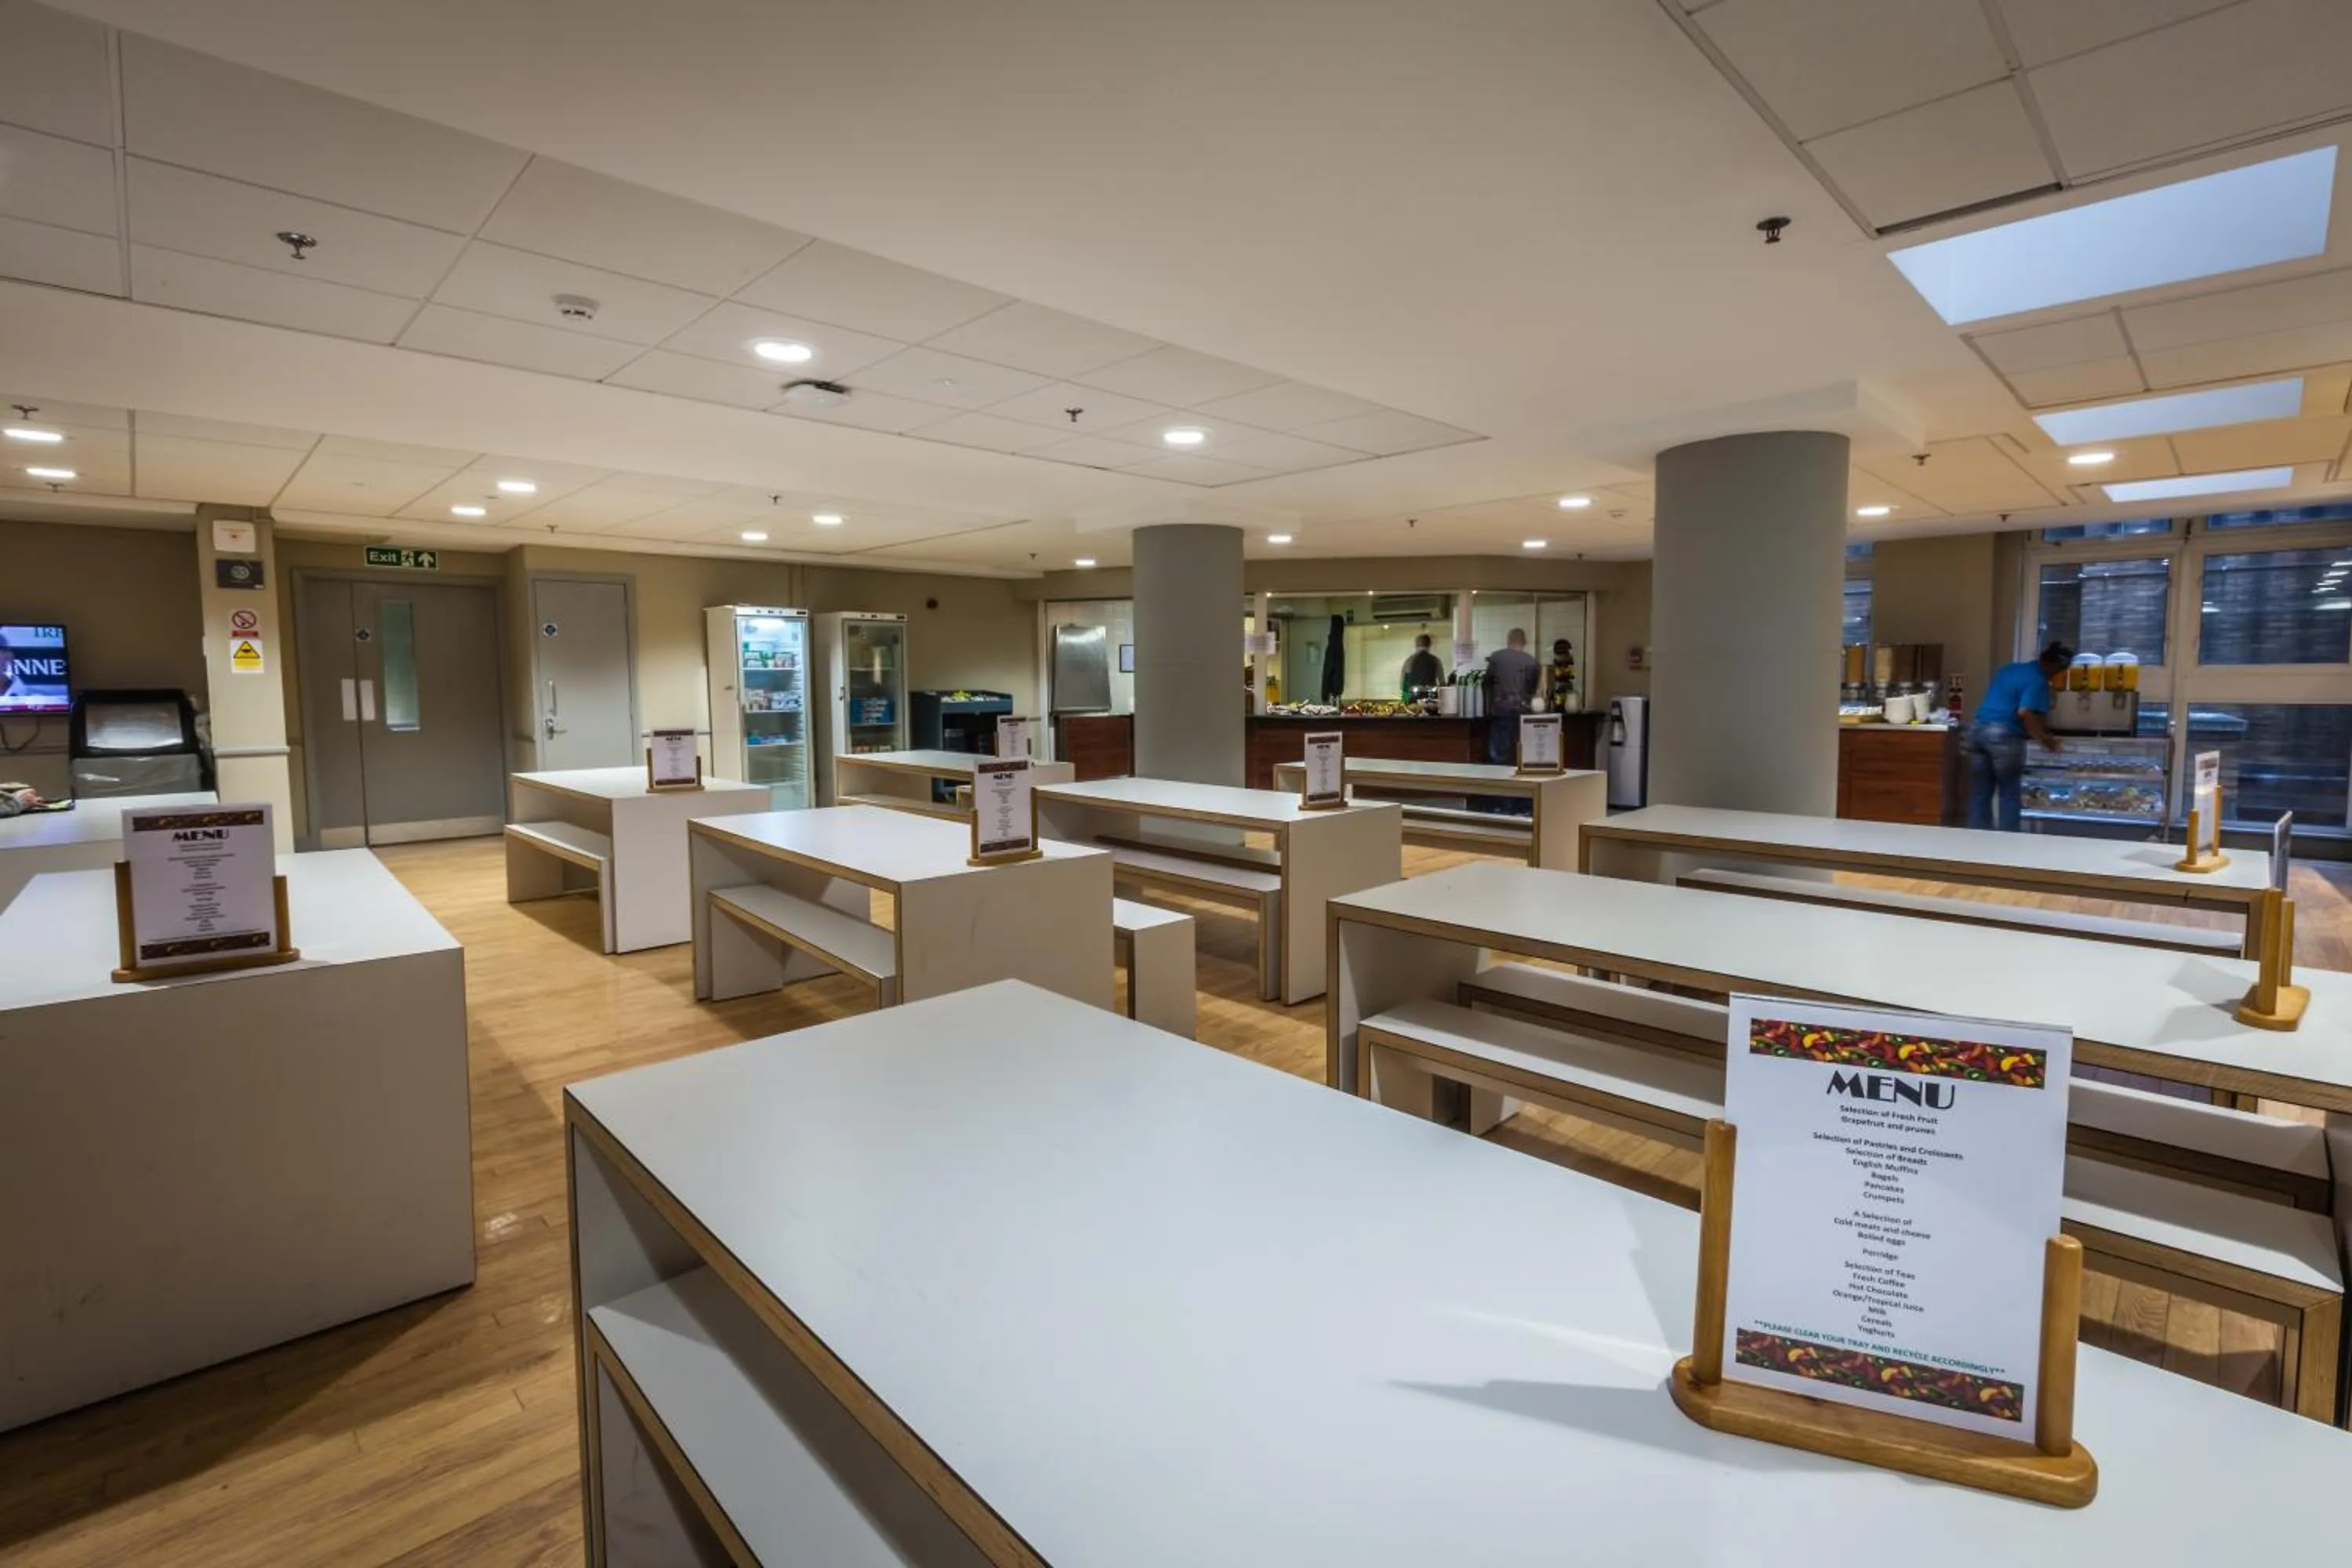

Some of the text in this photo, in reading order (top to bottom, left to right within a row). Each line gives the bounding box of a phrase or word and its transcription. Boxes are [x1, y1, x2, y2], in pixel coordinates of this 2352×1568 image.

[369, 551, 397, 563] Exit
[172, 829, 230, 842] MENU
[1826, 1069, 1955, 1109] MENU
[1840, 1105, 1879, 1117] Selection
[1892, 1112, 1915, 1122] Fresh
[1918, 1116, 1938, 1124] Fruit
[1841, 1116, 1936, 1135] Grapefruit and prunes
[1813, 1132, 1851, 1144] Selection
[1864, 1140, 1897, 1151] Pastries
[1918, 1147, 1963, 1160] Croissants
[1846, 1147, 1884, 1159] Selection
[1897, 1155, 1928, 1165] Breads
[1853, 1159, 1918, 1175] English Muffins
[1871, 1171, 1899, 1182] Bagels
[1864, 1181, 1904, 1193] Pancakes
[1863, 1191, 1904, 1204] Crumpets
[1862, 1211, 1901, 1224] Selection
[1834, 1217, 1853, 1226] Cold
[1855, 1221, 1880, 1231] meats
[1900, 1229, 1931, 1239] cheese
[1857, 1232, 1906, 1247] Boiled eggs
[1862, 1248, 1899, 1261] Porridge
[1844, 1260, 1882, 1273] Selection
[1896, 1269, 1915, 1279] Teas
[1853, 1272, 1905, 1287] Fresh Coffee
[1865, 1285, 1908, 1298] Chocolate
[1832, 1289, 1925, 1312] Orange/Tropical Juice
[1868, 1306, 1886, 1316] Milk
[1861, 1315, 1893, 1327] Cereals
[1857, 1324, 1895, 1338] Yoghurts
[1794, 1328, 1820, 1340] CLEAR
[1821, 1333, 1845, 1343] YOUR
[1847, 1339, 1869, 1348] TRAY
[1871, 1343, 1890, 1353] AND
[1893, 1348, 1929, 1362] RECYCLE
